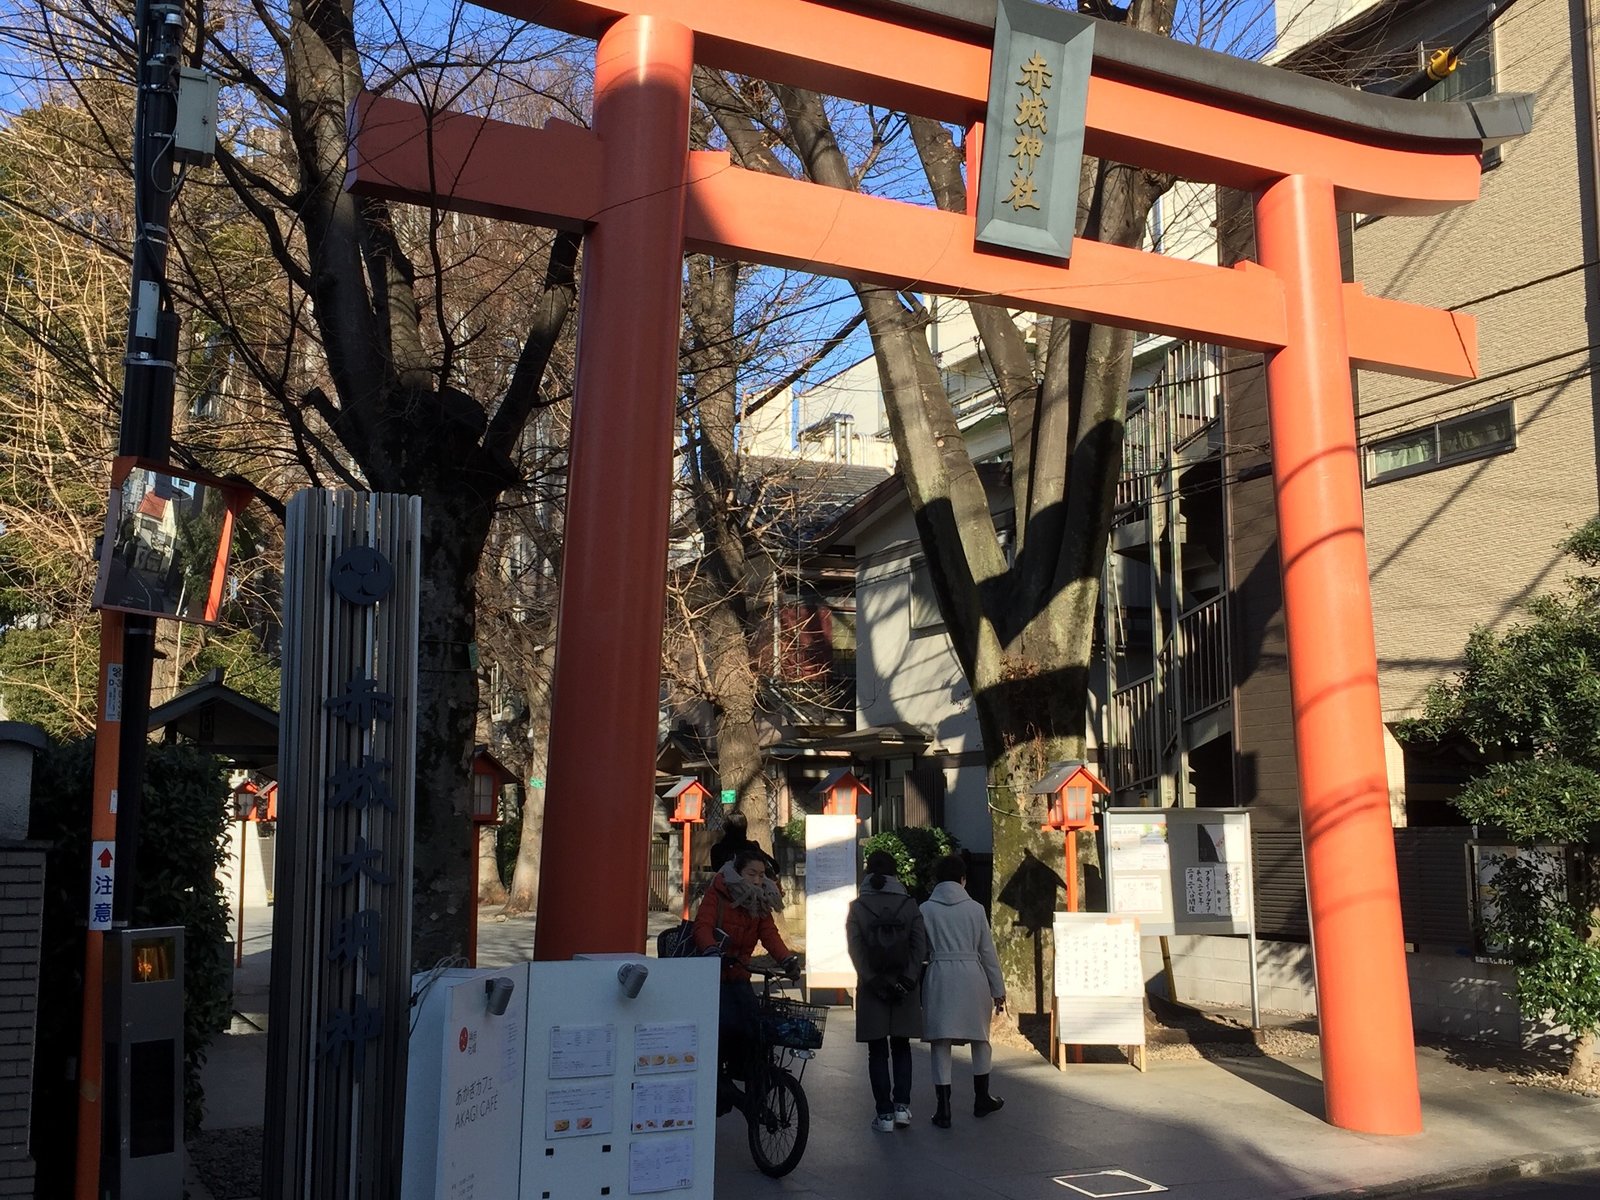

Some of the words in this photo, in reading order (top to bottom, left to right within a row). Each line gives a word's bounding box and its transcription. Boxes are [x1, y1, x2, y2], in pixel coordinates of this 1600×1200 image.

[1001, 49, 1053, 212] 赤城神社
[93, 874, 112, 923] 注意
[315, 665, 397, 1084] 赤城大明神
[455, 1075, 494, 1106] あかぎカフェ
[454, 1103, 479, 1131] AKAGI
